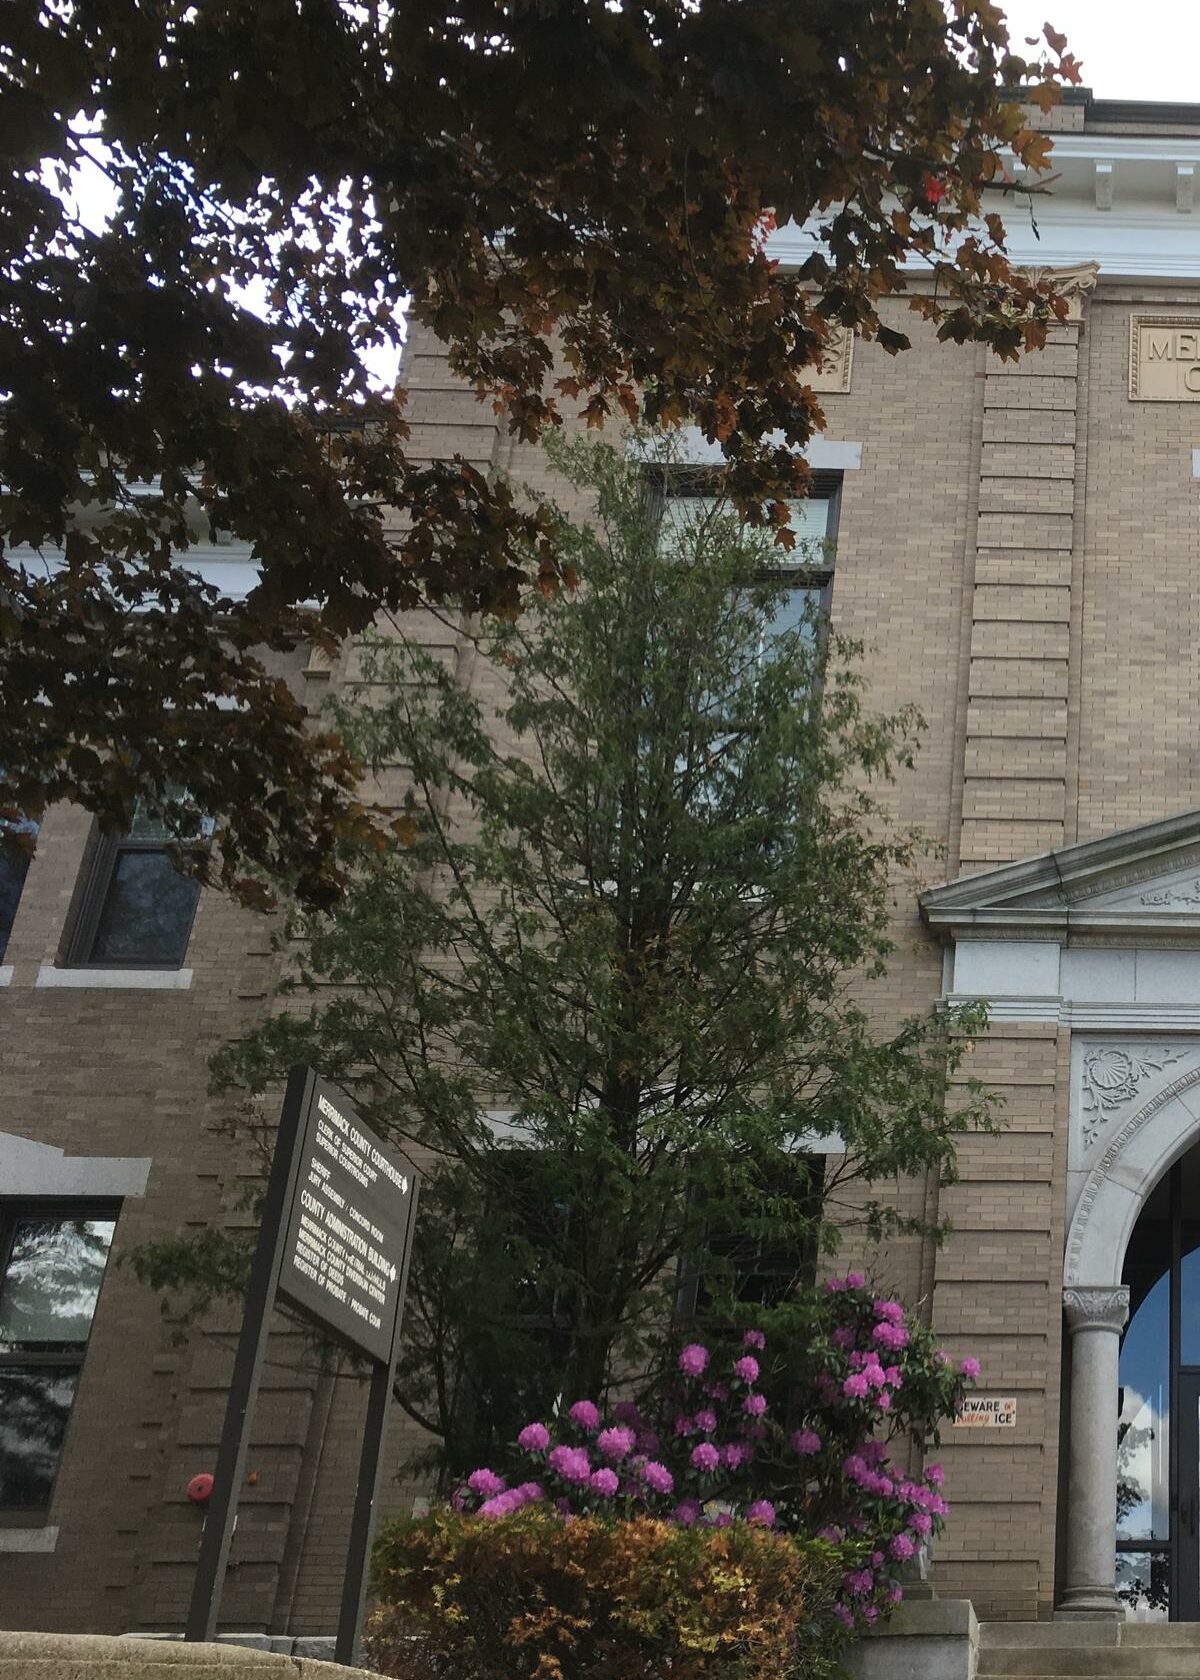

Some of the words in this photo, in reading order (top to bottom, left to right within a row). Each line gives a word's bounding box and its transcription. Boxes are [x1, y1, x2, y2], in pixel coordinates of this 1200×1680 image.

[316, 1132, 339, 1160] SUPERIOR
[318, 1095, 350, 1137] MERRIMACK
[350, 1128, 372, 1157] COUNTY
[371, 1149, 403, 1189] COURTHOUSE
[318, 1120, 334, 1141] CLERK
[334, 1135, 342, 1147] OF
[342, 1142, 363, 1169] SUPERIOR
[363, 1163, 378, 1182] COURT
[301, 1214, 328, 1244] MERRIMACK
[301, 1190, 326, 1220] COUNTY
[325, 1211, 368, 1257] ADMINISTRATION
[368, 1247, 391, 1277] BUILDING
[308, 1171, 322, 1188] JURY
[321, 1182, 345, 1209] ASSEMBLY
[350, 1207, 371, 1232] CONCORD
[371, 1225, 384, 1244] ROOM
[294, 1255, 318, 1281] REGISTER
[318, 1274, 326, 1286] OF
[326, 1280, 347, 1303] PROBATE
[351, 1298, 369, 1321] PROBATE
[296, 1241, 320, 1267] REGISTER
[321, 1260, 328, 1272] OF
[328, 1266, 344, 1286] DEEDS
[299, 1228, 327, 1258] MERRIMACK
[327, 1251, 346, 1273] COUNTY
[369, 1284, 386, 1305] CENTER
[961, 1400, 1000, 1411] EWARE
[994, 1413, 1012, 1424] ICE
